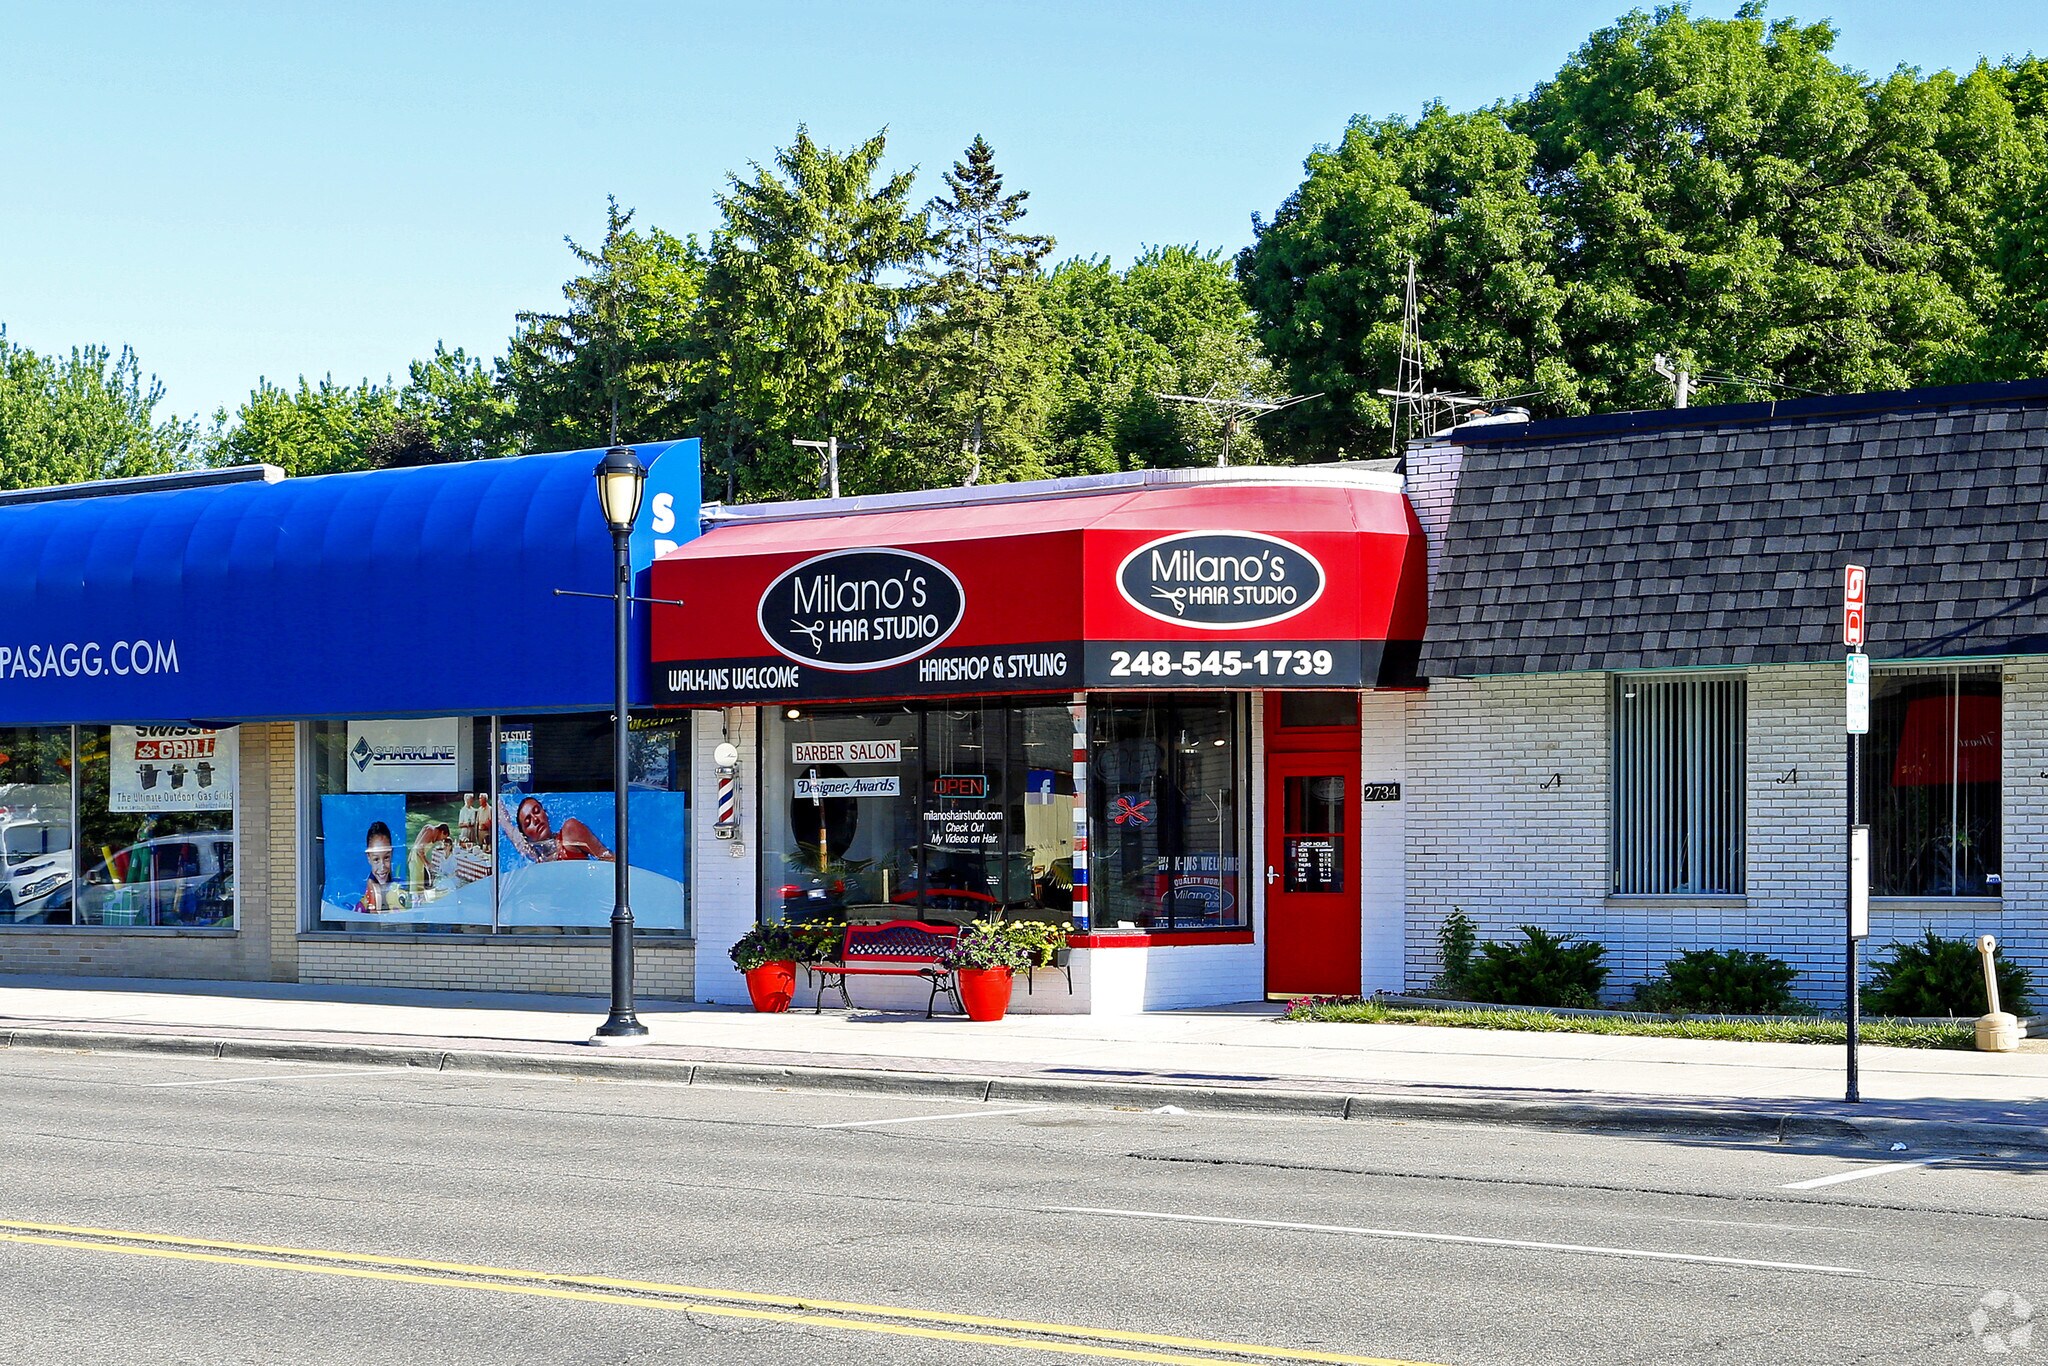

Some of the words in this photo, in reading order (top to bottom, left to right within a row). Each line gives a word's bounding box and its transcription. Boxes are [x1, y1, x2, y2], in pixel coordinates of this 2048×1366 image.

[1151, 549, 1286, 582] Milano's
[793, 569, 928, 614] Milano's
[1189, 586, 1229, 605] HAIR
[1233, 585, 1297, 605] STUDIO
[829, 618, 869, 643] HAIR
[873, 614, 939, 641] STUDIO
[0, 638, 180, 679] PASAGG.COM
[919, 656, 990, 682] HAIRSHOP
[992, 655, 1005, 679] &
[1007, 652, 1067, 678] STYLING
[1109, 649, 1333, 677] 248-545-1739
[668, 668, 729, 692] WALK-INS
[732, 665, 799, 690] WELCOME
[511, 731, 531, 742] STYLE
[159, 739, 214, 759] GRILL
[373, 746, 455, 761] SHARKLINE
[796, 745, 844, 760] BARBER
[850, 743, 896, 760] SALON
[507, 764, 532, 775] CENTER
[844, 778, 895, 795] Awards
[934, 779, 983, 794] OPEN
[1365, 786, 1397, 800] 2734
[117, 792, 131, 803] The
[133, 791, 162, 803] Ultimate
[164, 791, 195, 802] Outdoor
[197, 790, 212, 801] Gas
[923, 810, 1003, 821] milanoshairstudio.com
[945, 823, 968, 832] Check
[970, 822, 984, 832] Out
[931, 834, 943, 845] My
[945, 834, 968, 843] Videos
[970, 835, 980, 843] on
[982, 834, 999, 843] Hair.
[1173, 877, 1201, 887] QUALITY
